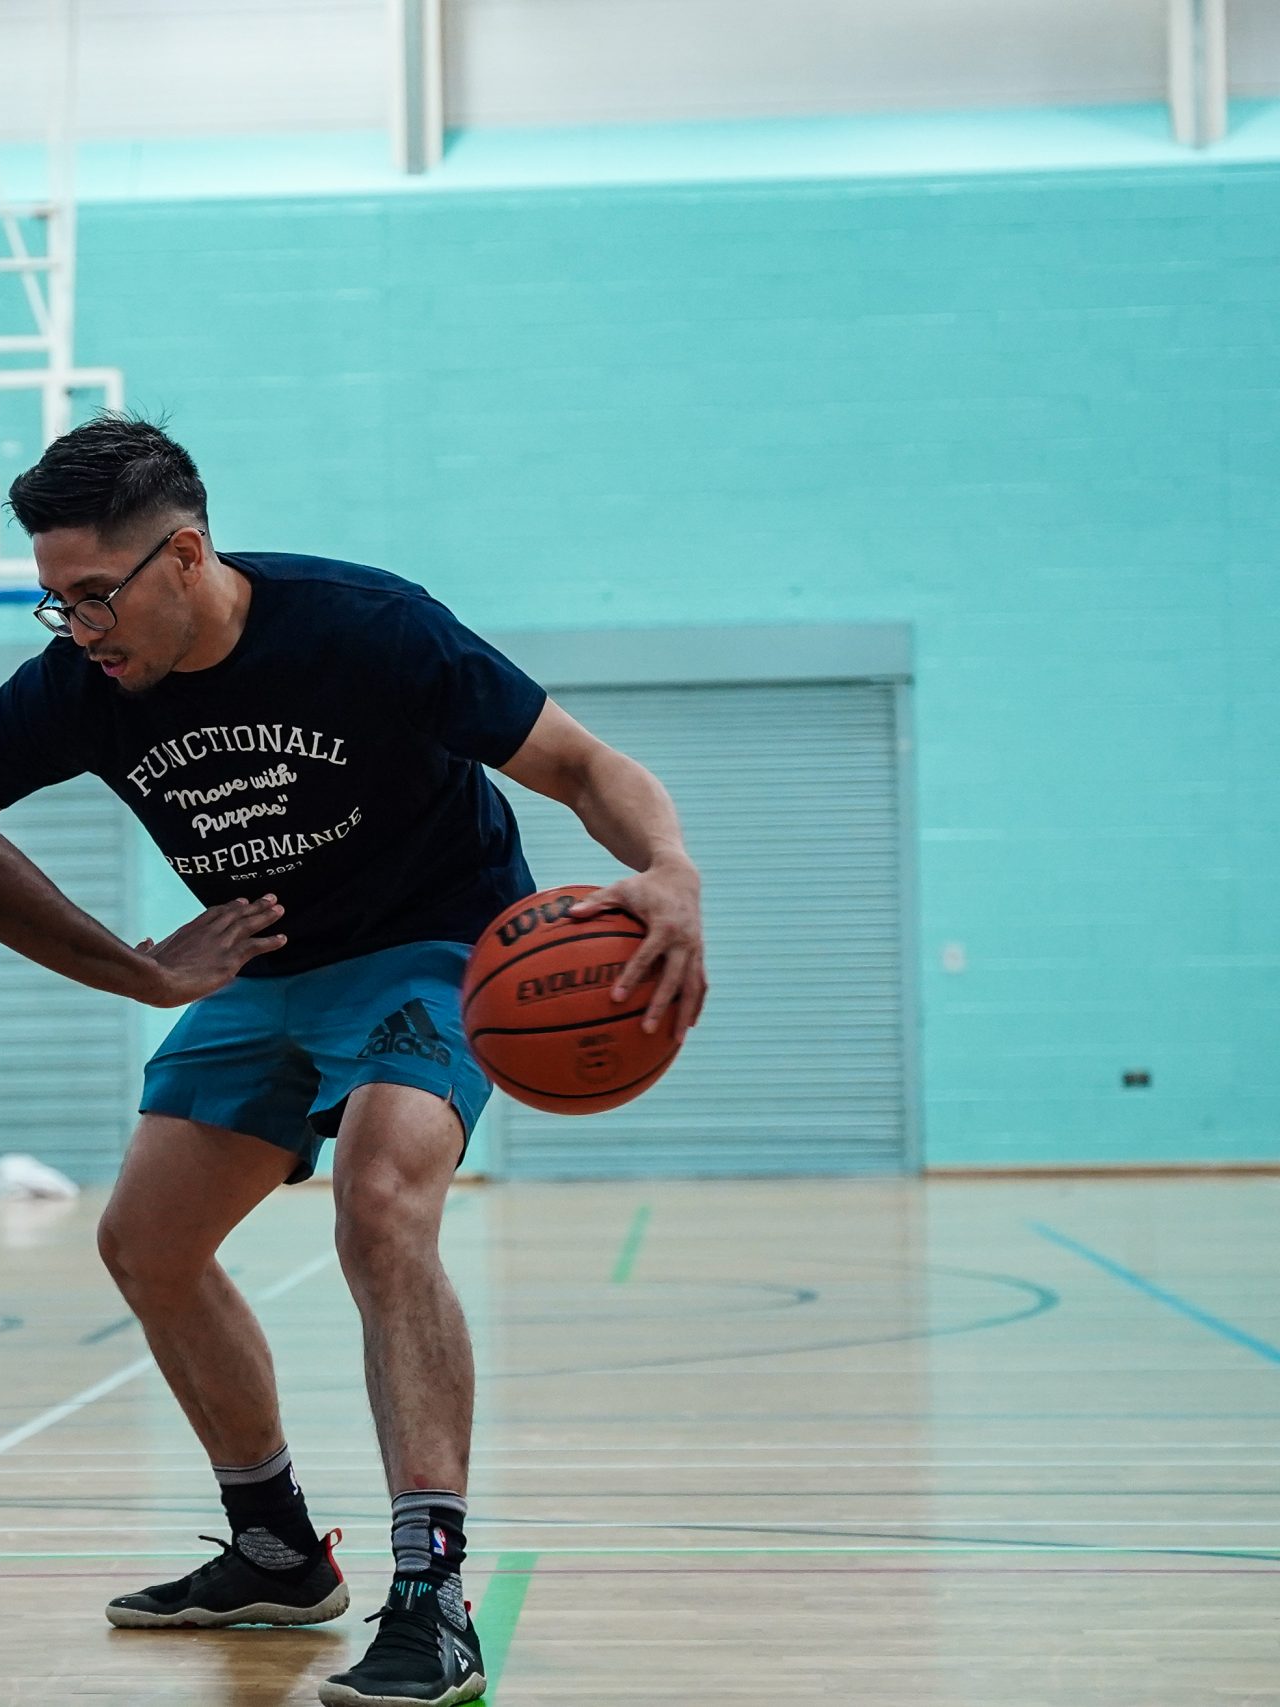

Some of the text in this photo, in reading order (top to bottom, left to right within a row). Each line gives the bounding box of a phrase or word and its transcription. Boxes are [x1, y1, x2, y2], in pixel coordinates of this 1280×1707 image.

[126, 723, 348, 798] FUNCTIONALL
[164, 762, 298, 810] "Move with
[191, 794, 289, 839] Purpose"
[516, 960, 628, 1001] EVOLUT
[356, 1031, 453, 1068] adidas
